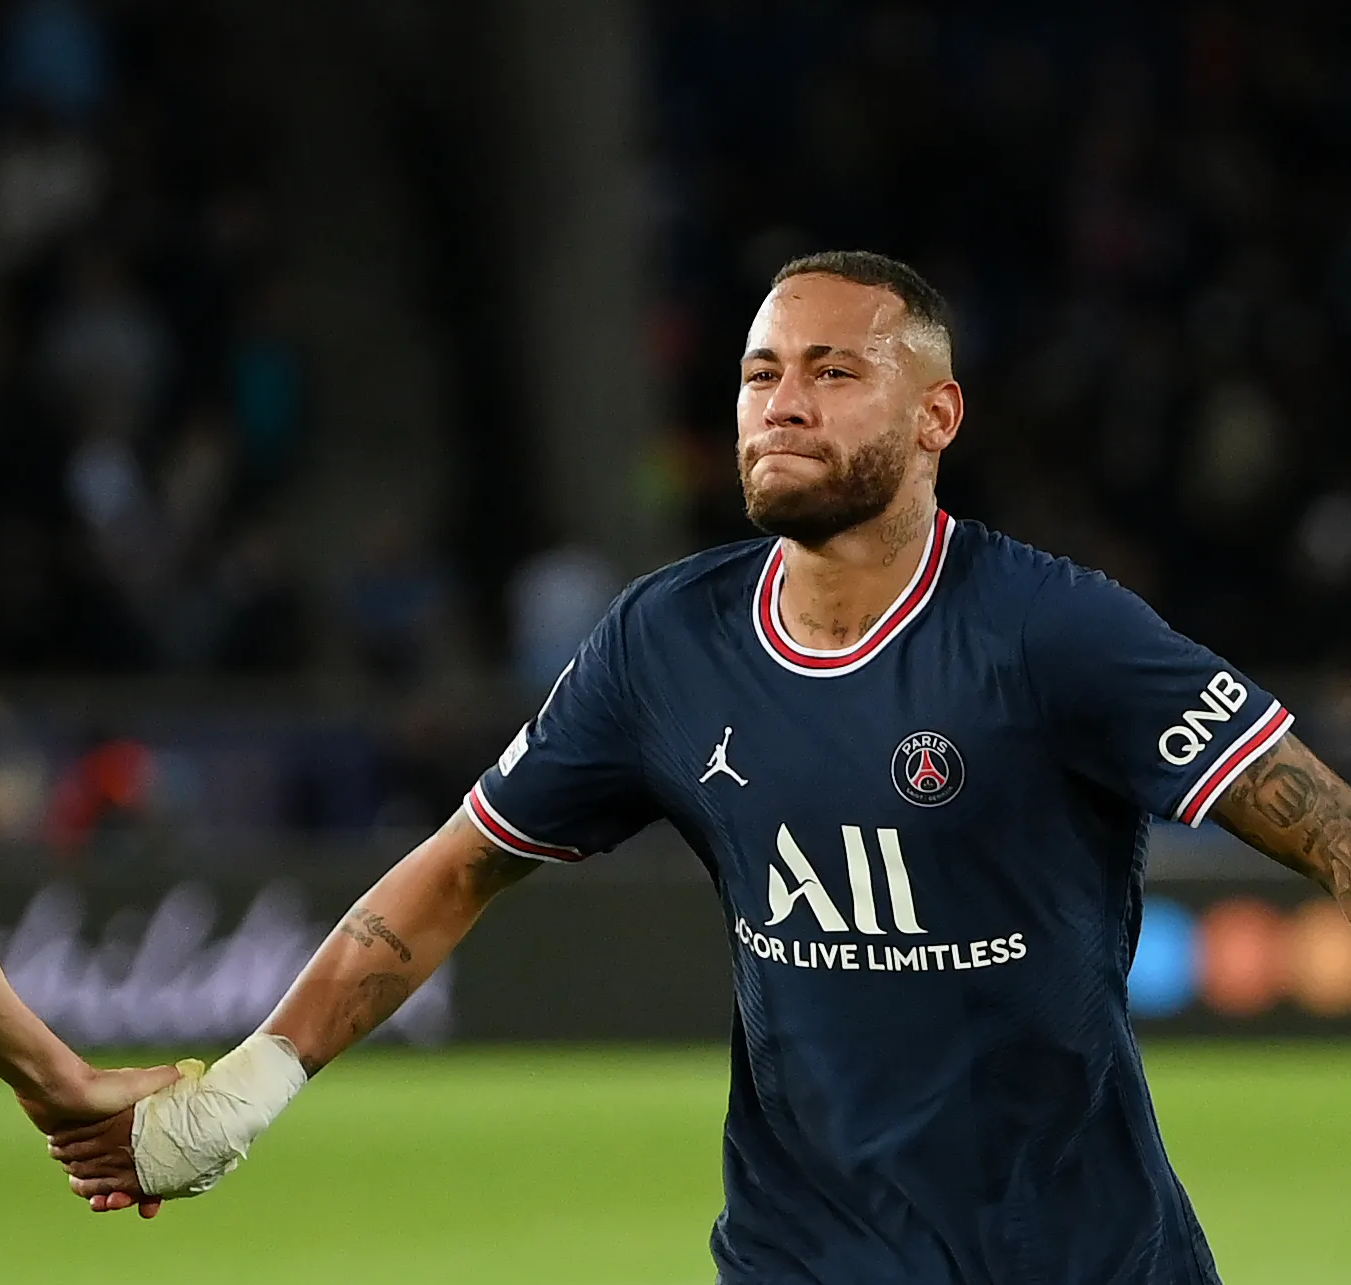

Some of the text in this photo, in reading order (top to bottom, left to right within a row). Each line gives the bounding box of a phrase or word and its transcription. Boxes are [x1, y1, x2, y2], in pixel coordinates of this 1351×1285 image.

[1158, 670, 1248, 766] QNB
[901, 735, 948, 756] PARIS
[793, 940, 860, 970] LIVE
[868, 932, 1027, 972] LIMITLESS
